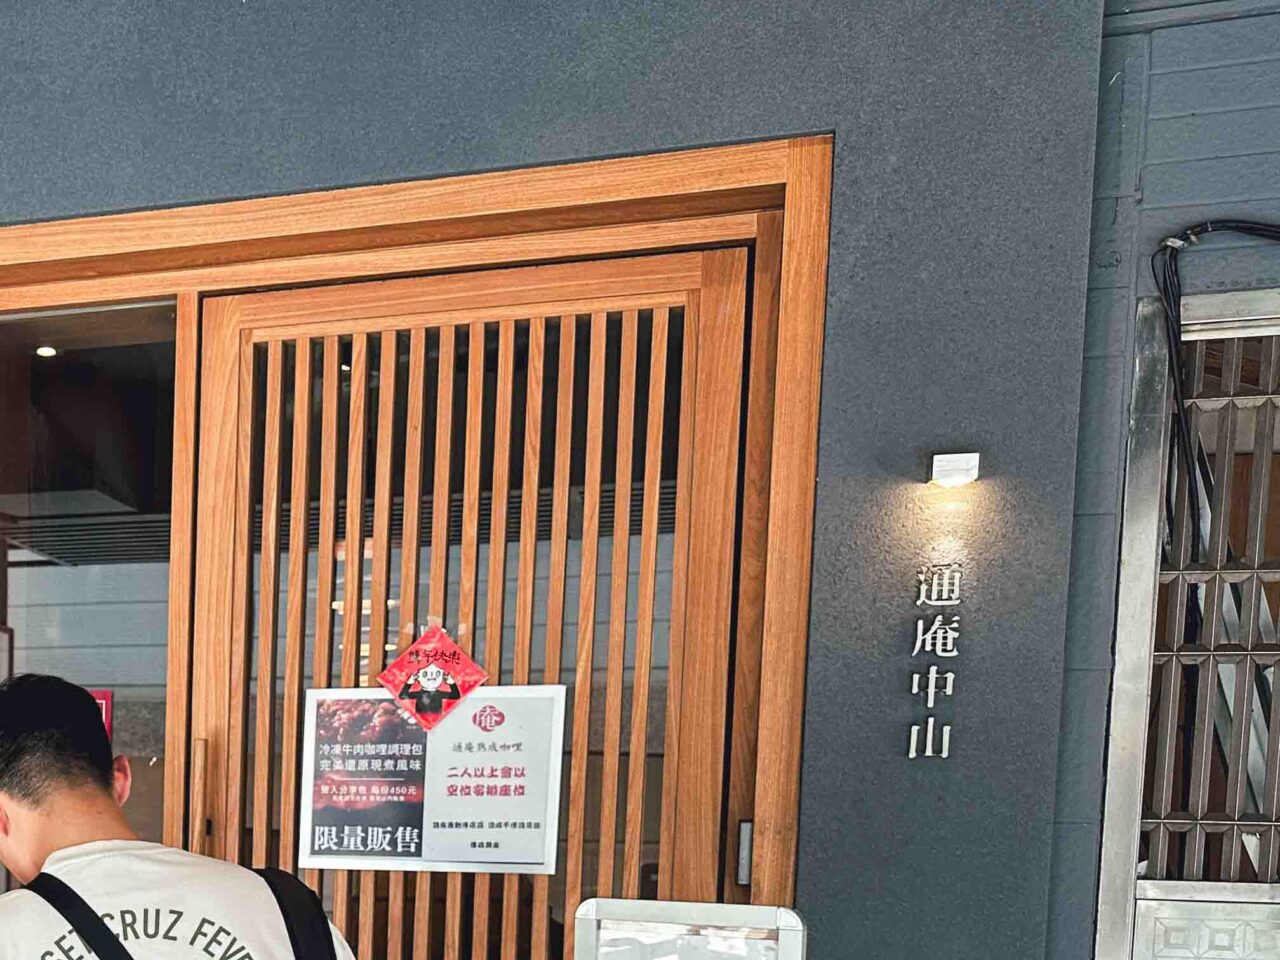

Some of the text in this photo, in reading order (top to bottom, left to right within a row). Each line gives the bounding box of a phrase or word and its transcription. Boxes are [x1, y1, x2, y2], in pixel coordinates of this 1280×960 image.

[907, 562, 962, 758] 通庵中山
[320, 743, 423, 756] 冷凍牛肉咖哩調理包
[319, 759, 422, 772] 完美還原現煮風味
[447, 766, 526, 779] 二人以上會以
[314, 826, 420, 853] 限量販售
